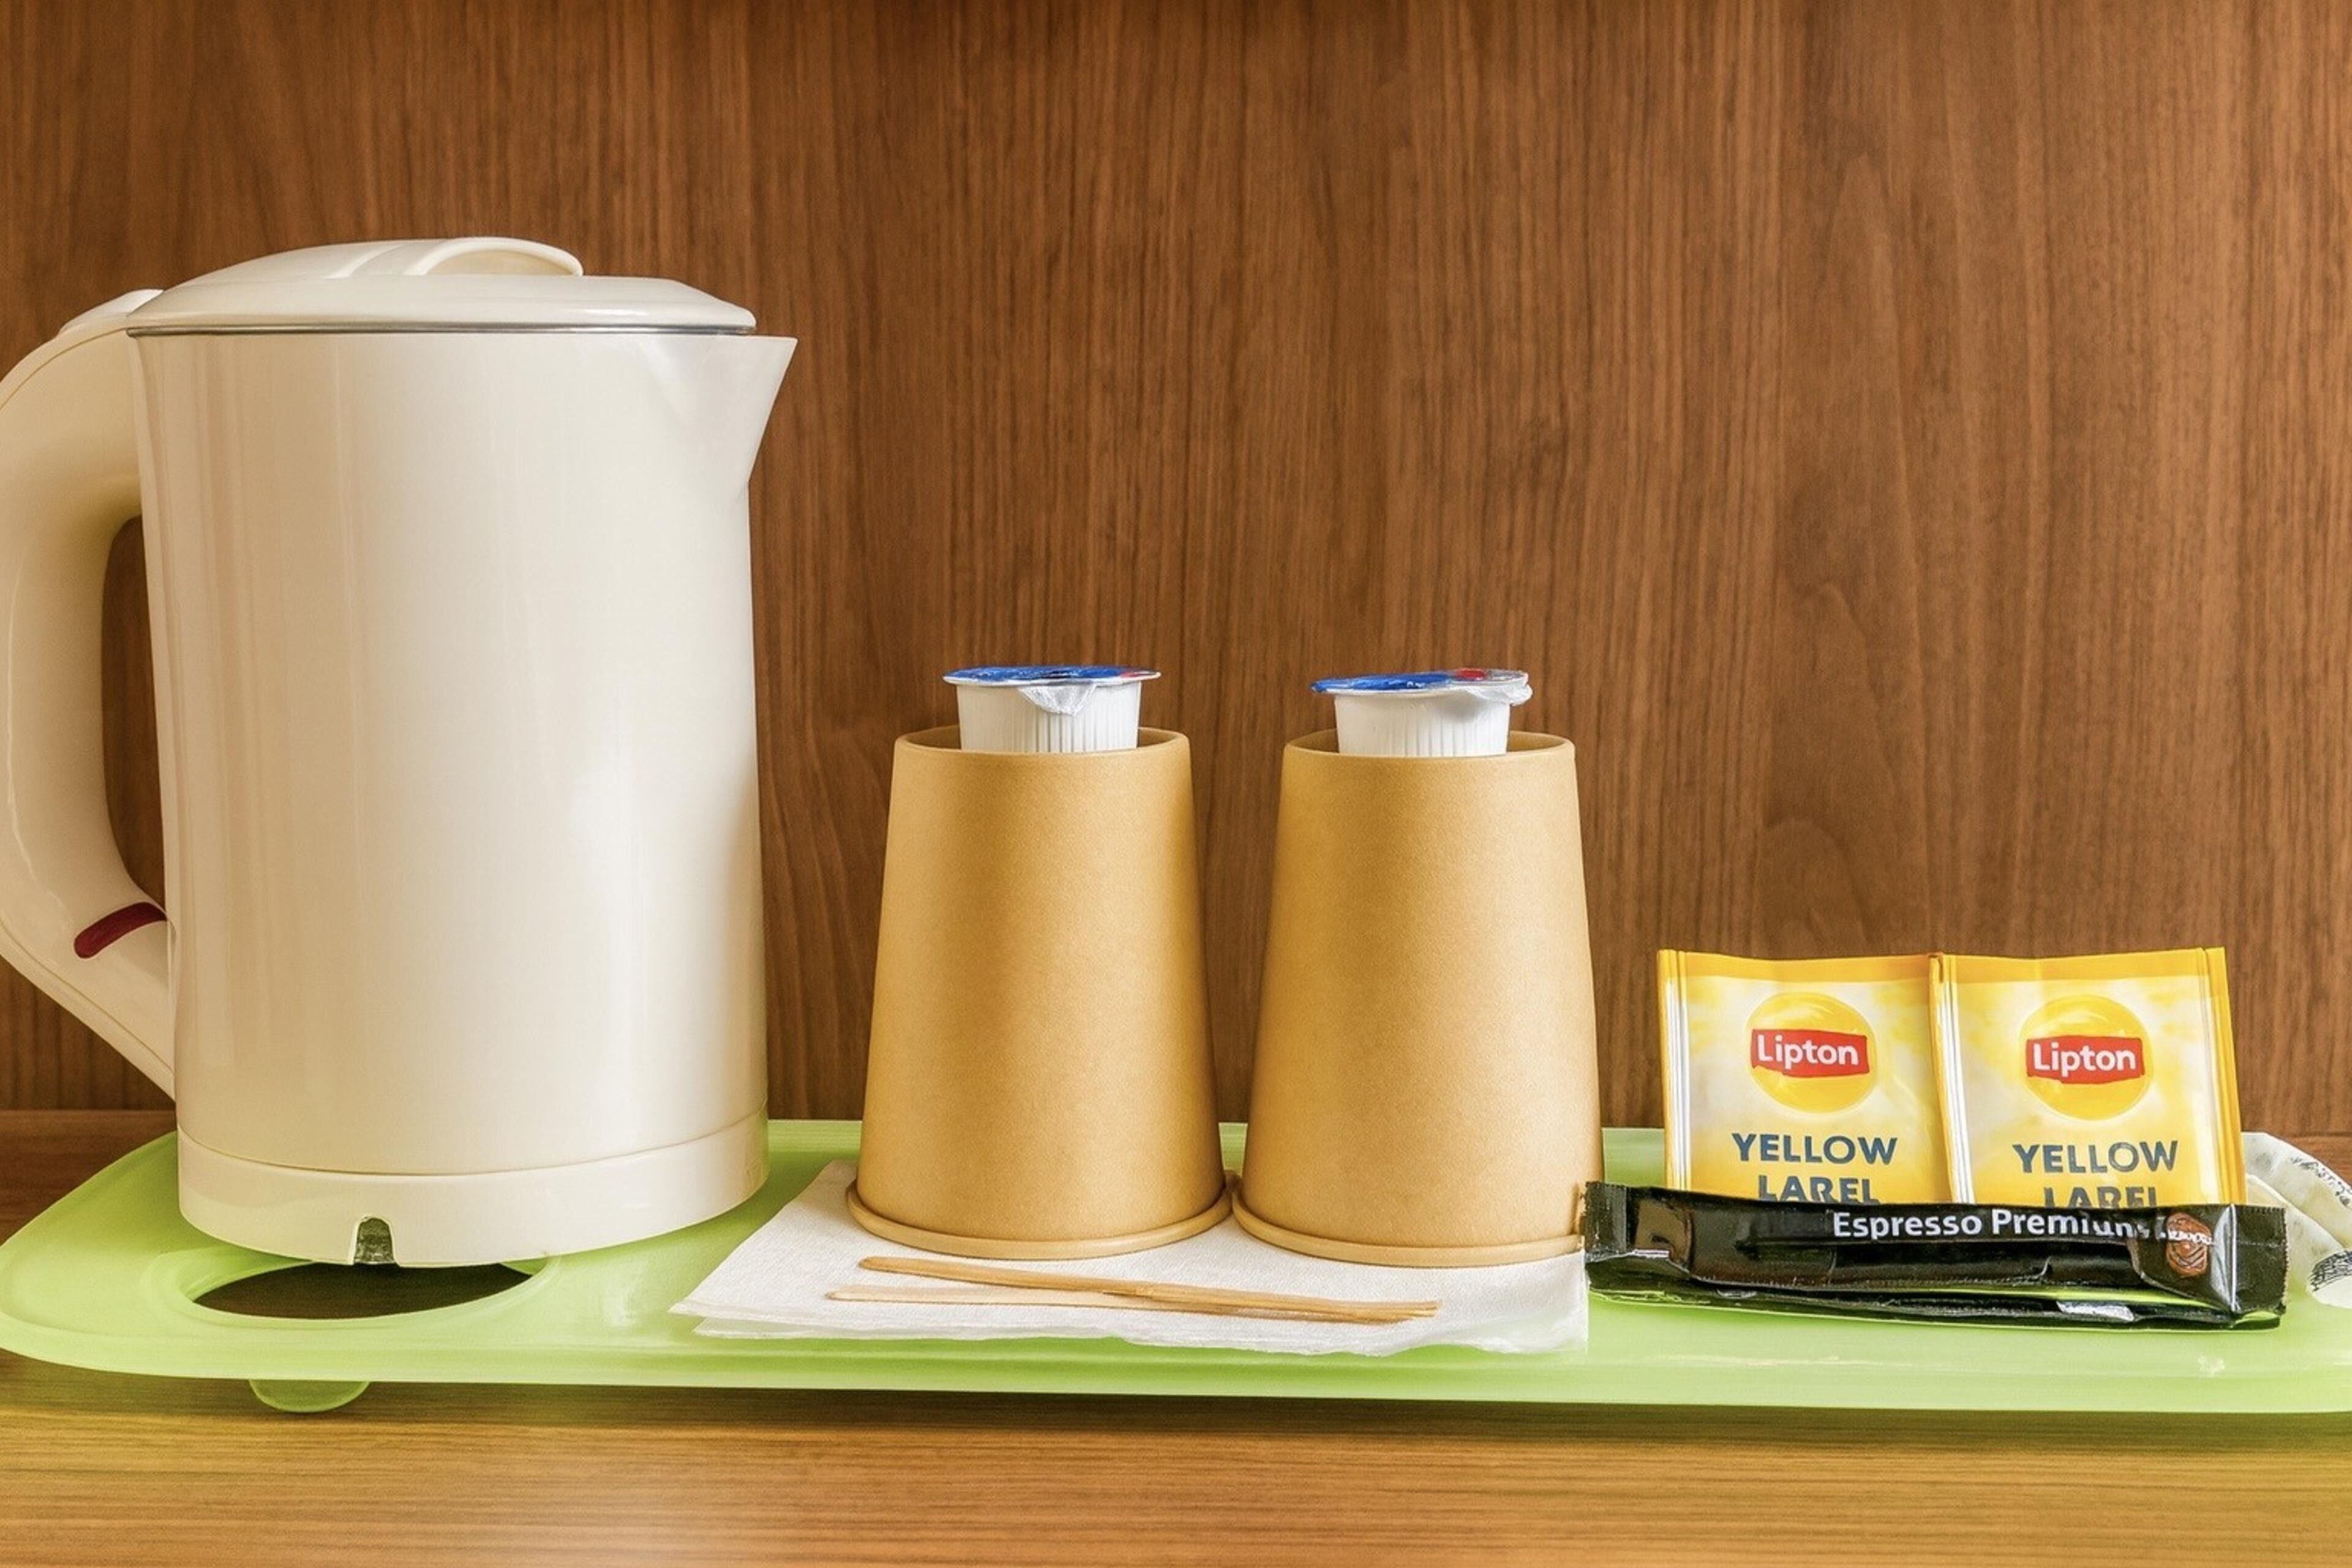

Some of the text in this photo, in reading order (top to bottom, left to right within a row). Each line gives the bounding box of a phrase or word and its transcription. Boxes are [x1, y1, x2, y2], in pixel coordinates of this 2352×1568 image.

[1757, 1035, 1858, 1069] Lipton
[2033, 1042, 2136, 1077] Lipton
[1732, 1133, 1898, 1164] YELLOW
[2012, 1140, 2178, 1174] YELLOW
[1833, 1212, 1982, 1240] Espresso
